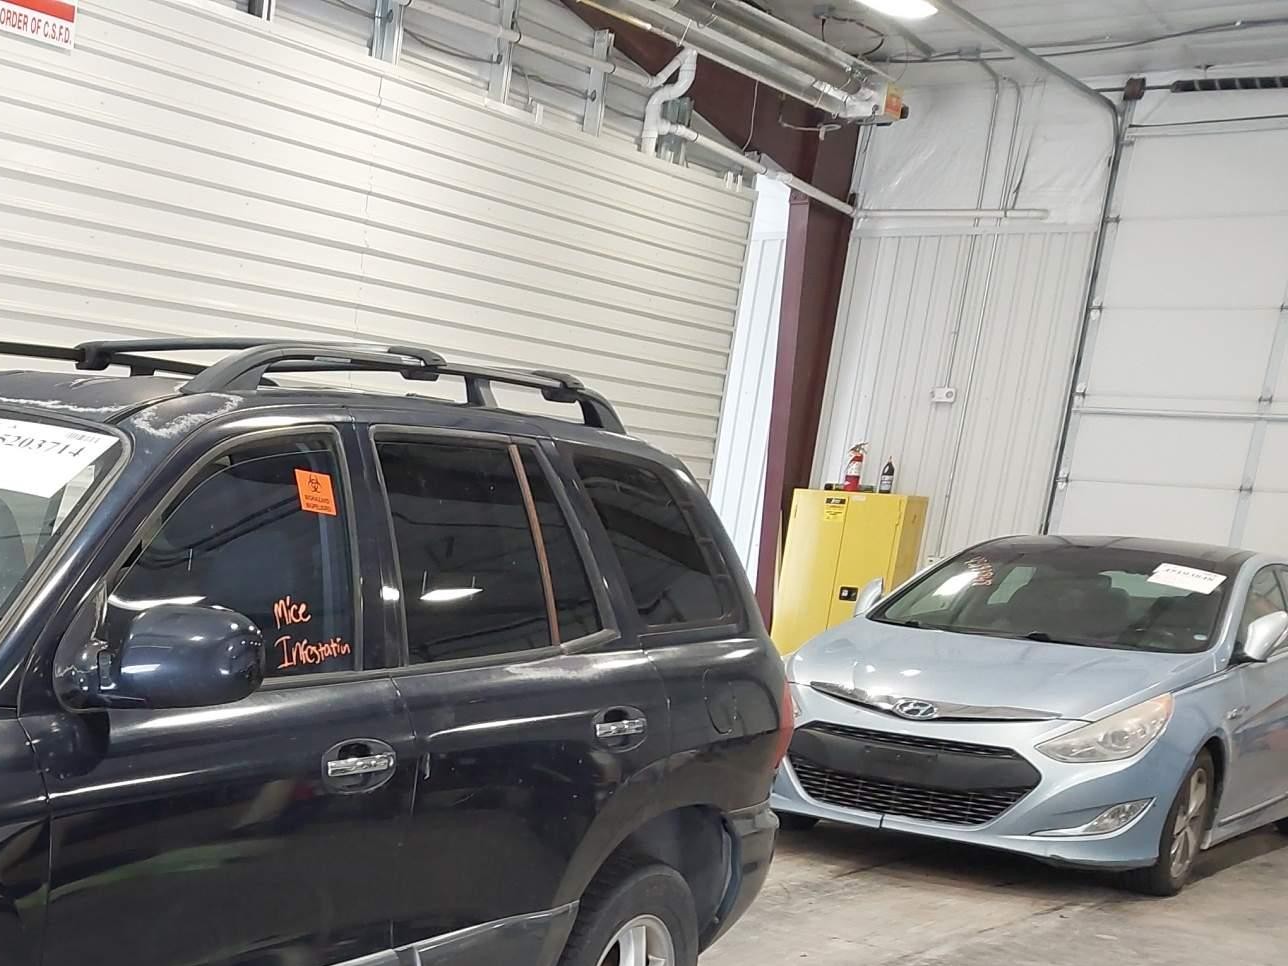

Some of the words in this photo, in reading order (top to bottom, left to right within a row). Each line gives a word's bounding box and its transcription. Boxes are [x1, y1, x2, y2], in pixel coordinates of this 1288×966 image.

[0, 8, 29, 32] ORDER
[30, 17, 42, 35] OF
[43, 21, 72, 45] C.S.F.D.
[273, 595, 312, 630] Mice
